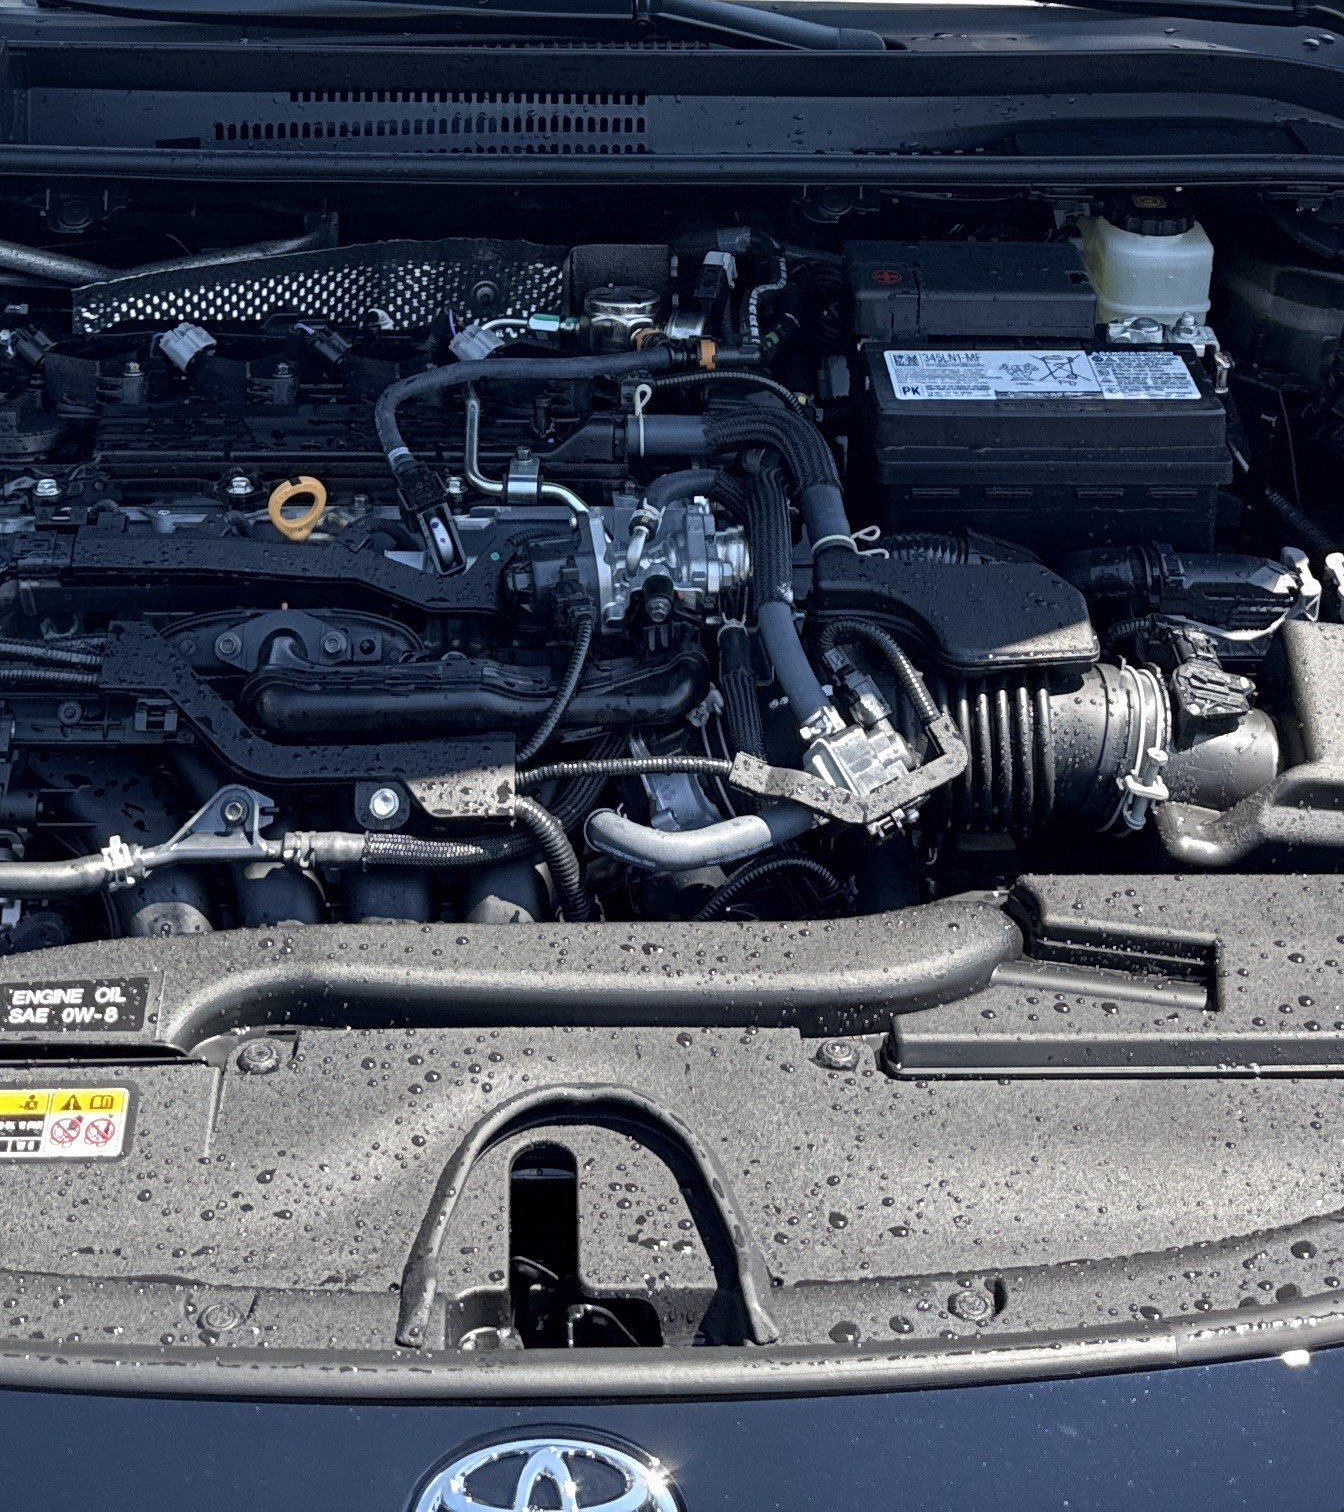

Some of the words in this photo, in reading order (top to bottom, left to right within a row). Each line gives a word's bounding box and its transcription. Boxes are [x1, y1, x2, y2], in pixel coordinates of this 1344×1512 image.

[902, 386, 921, 396] PK
[12, 988, 84, 1005] ENGINE
[94, 986, 127, 1003] OIL
[8, 1007, 50, 1023] SAE
[61, 1006, 119, 1023] 0W-8
